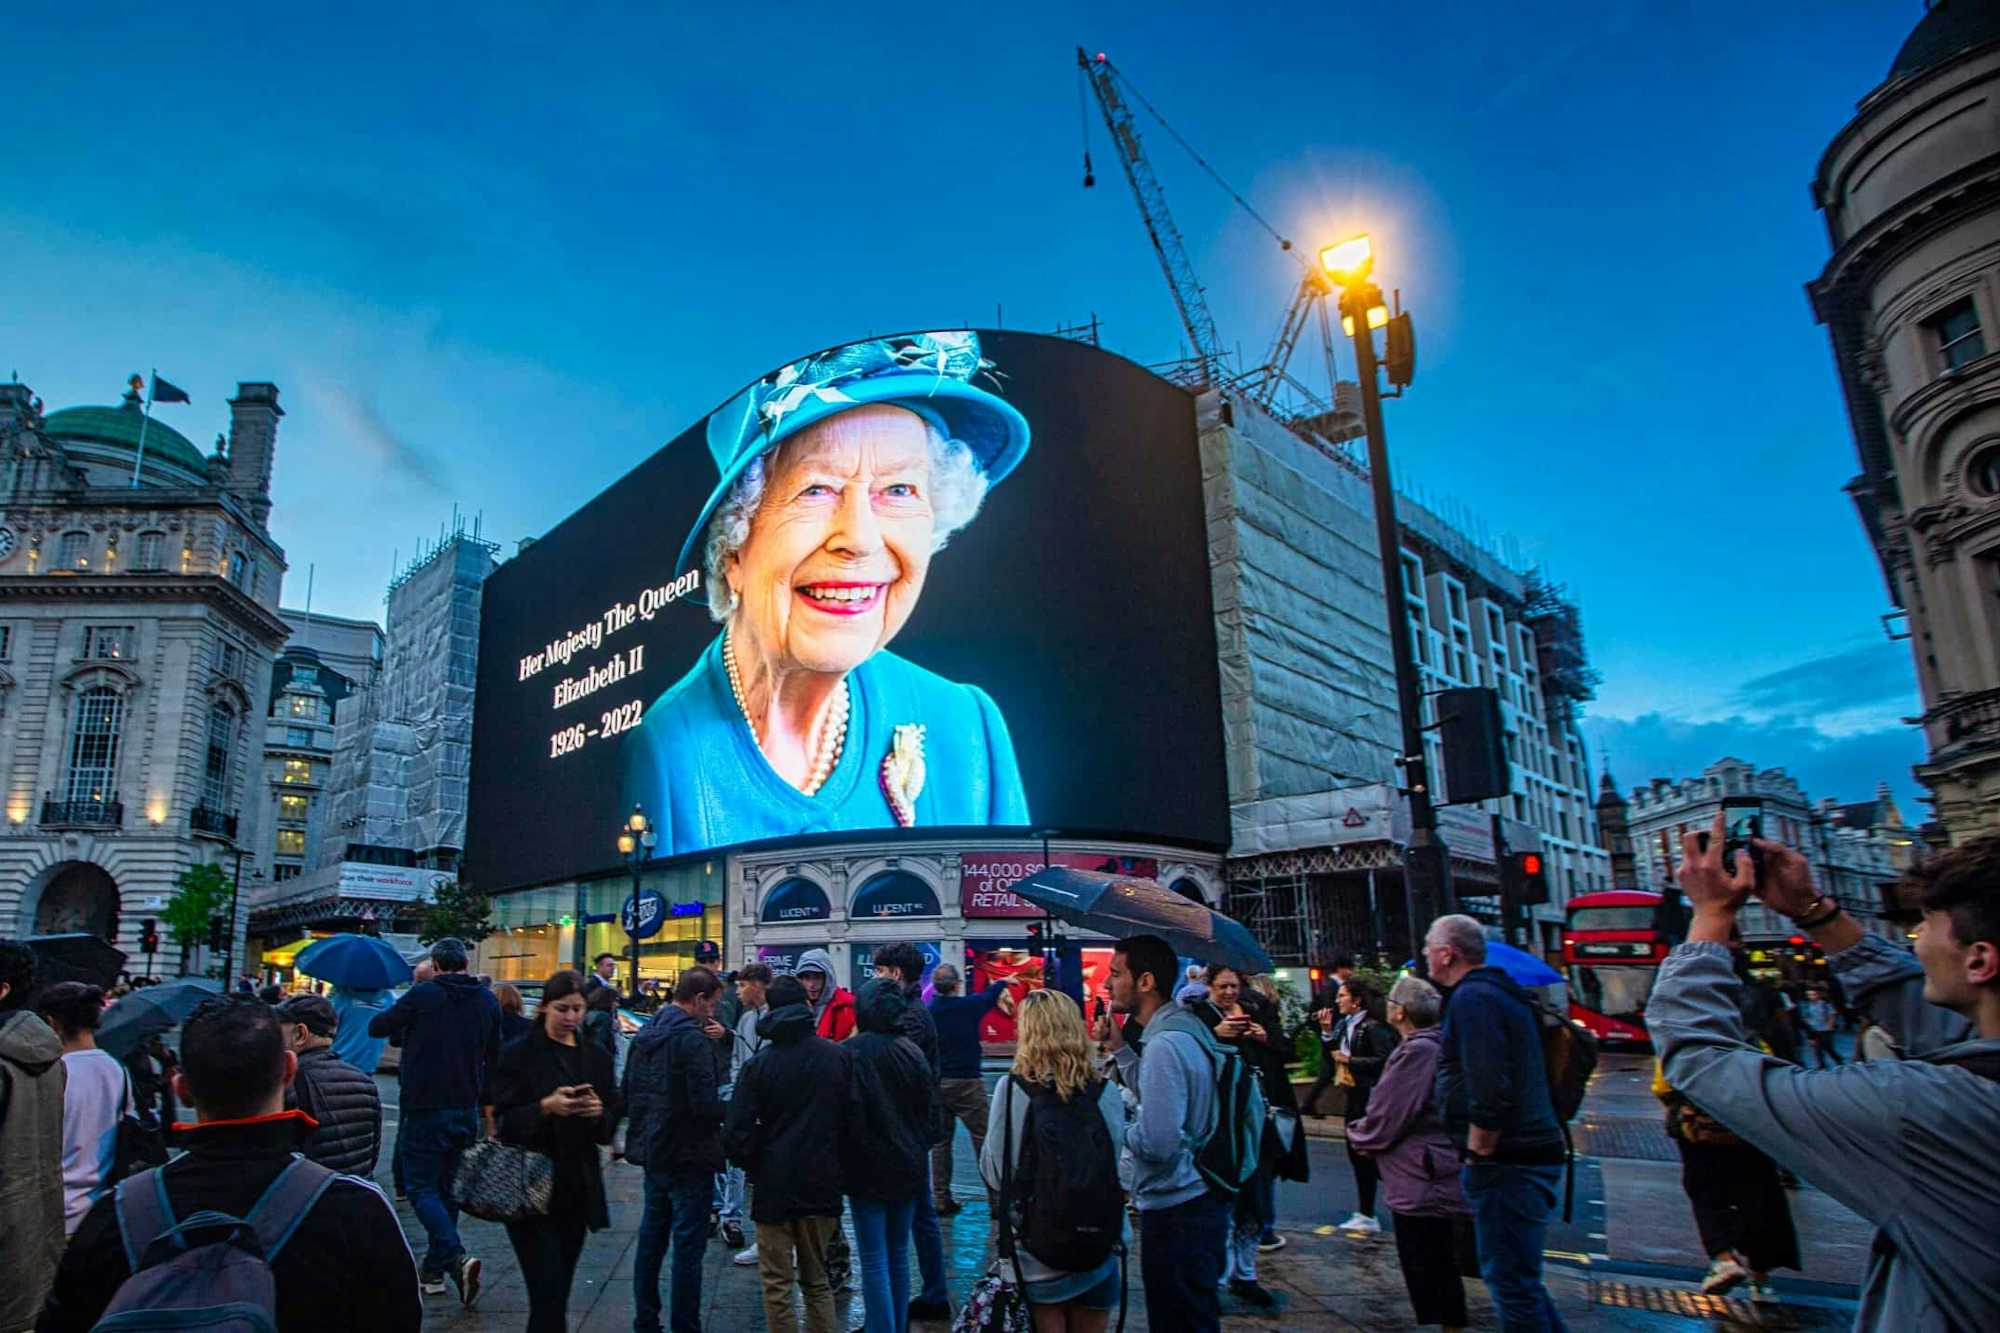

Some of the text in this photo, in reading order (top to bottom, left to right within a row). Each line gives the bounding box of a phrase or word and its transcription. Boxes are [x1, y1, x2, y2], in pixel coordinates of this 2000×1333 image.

[518, 569, 700, 681] Her Majesty The Queen
[553, 645, 644, 709] Elizabeth II
[550, 723, 586, 758] 1926
[601, 700, 643, 738] 2022
[962, 863, 1022, 878] 144,000
[979, 879, 993, 892] of
[972, 893, 1021, 907] RETAIL
[779, 907, 811, 918] LUCENT
[872, 902, 912, 914] LUCENT
